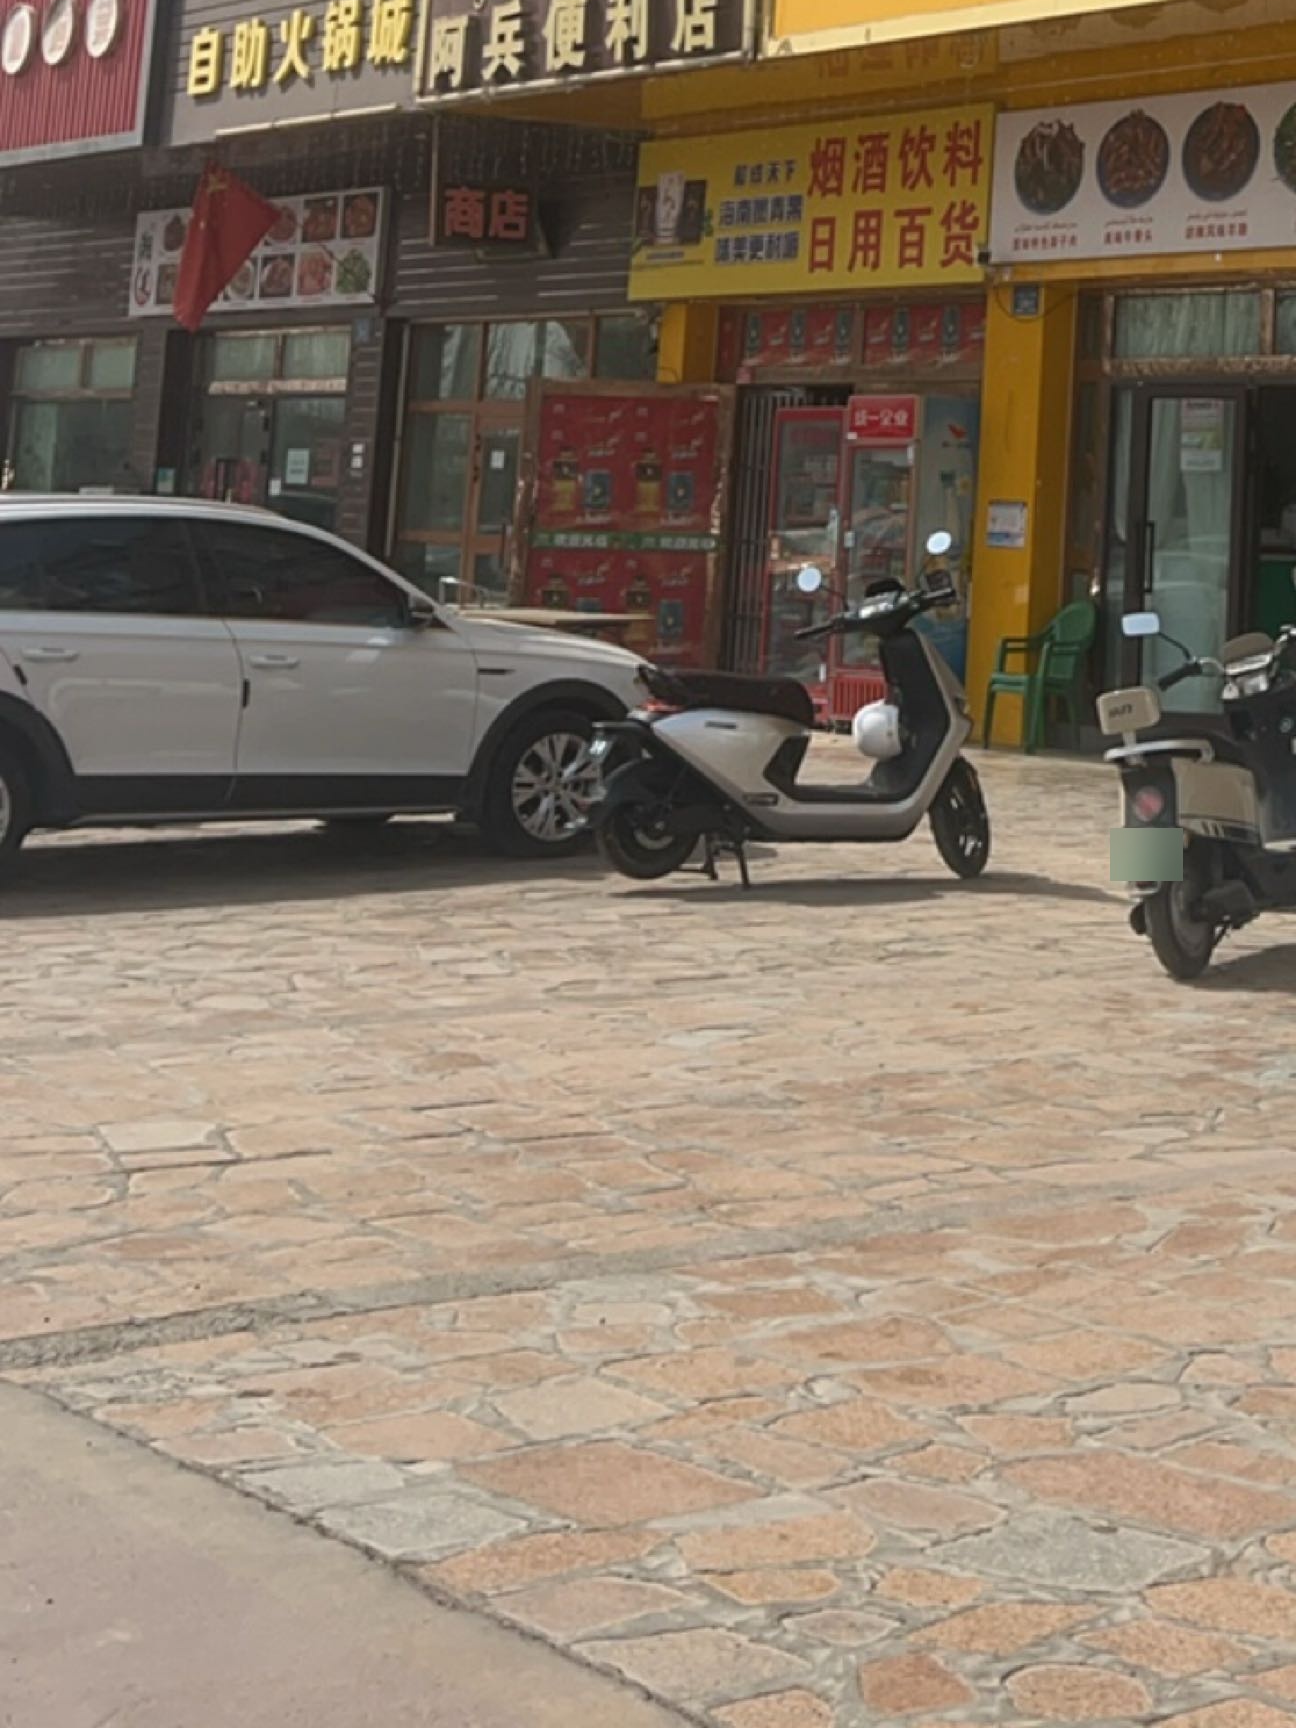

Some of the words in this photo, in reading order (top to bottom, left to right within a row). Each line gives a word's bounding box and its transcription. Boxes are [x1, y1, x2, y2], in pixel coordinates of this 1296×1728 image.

[806, 119, 984, 198] 烟酒饮料
[444, 186, 530, 239] 商店
[806, 199, 981, 273] 日用百货
